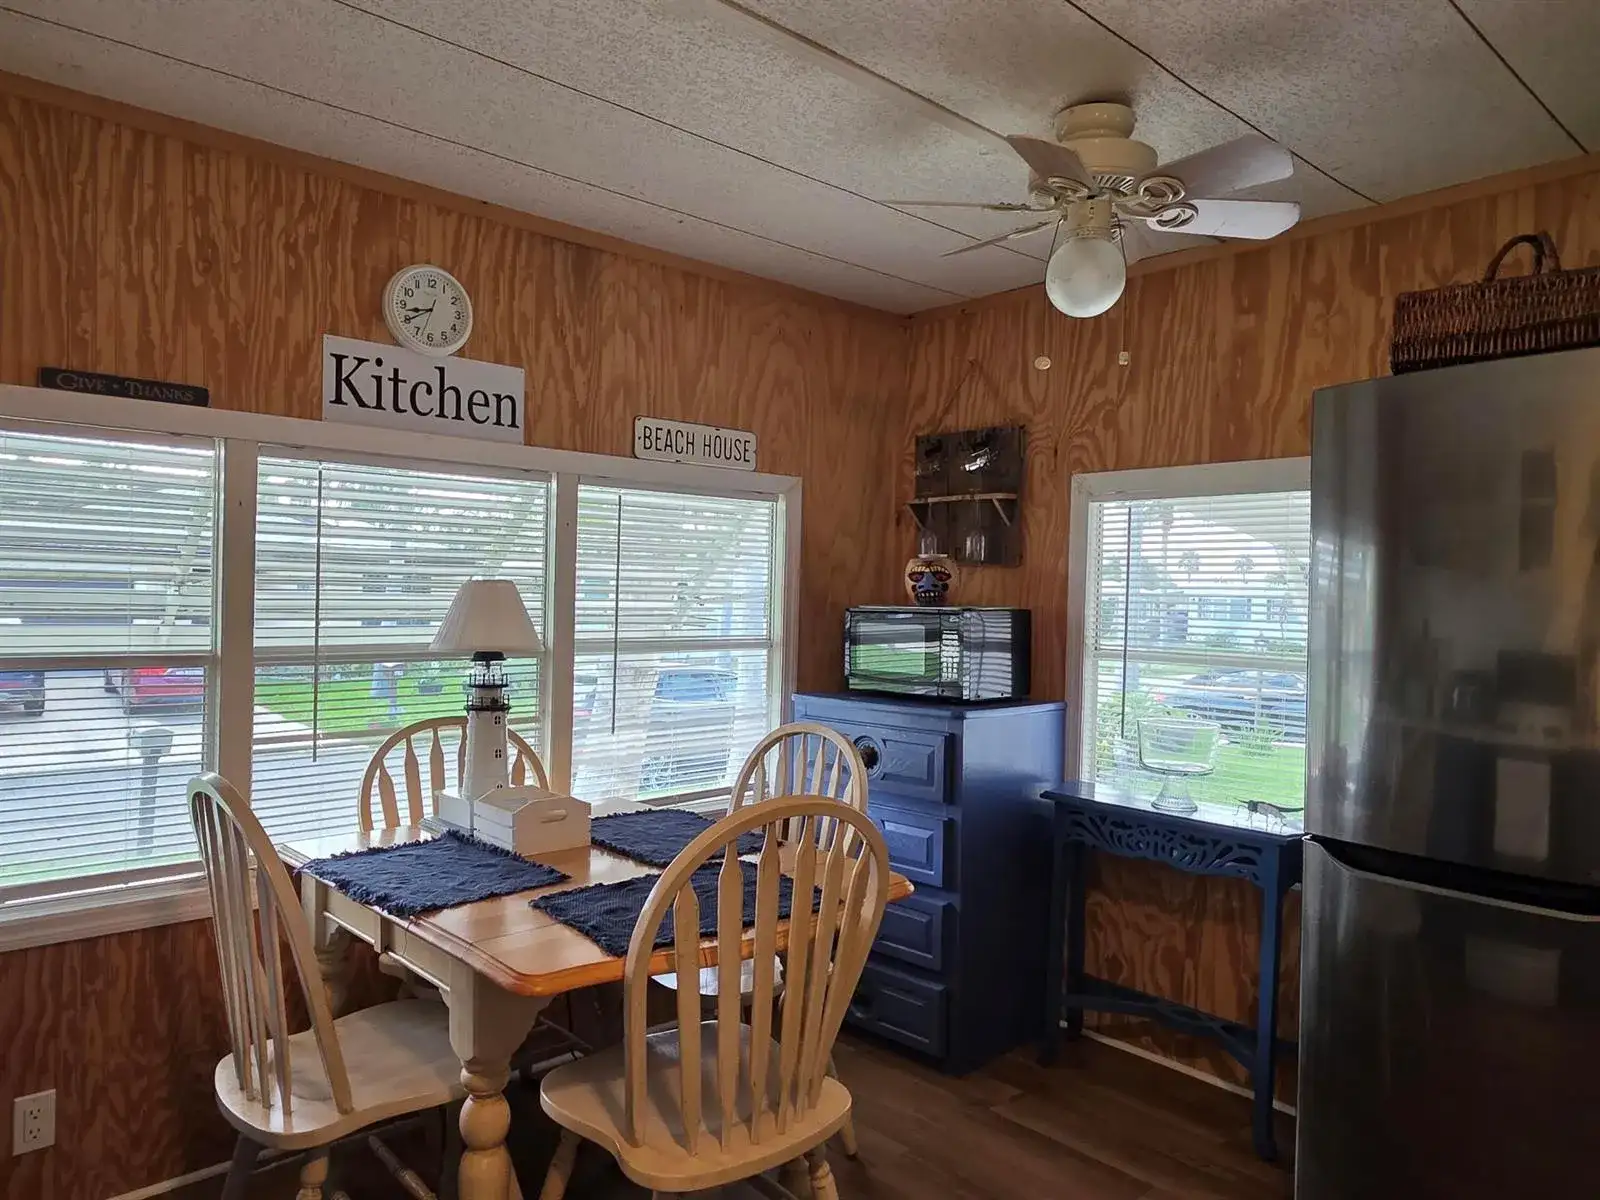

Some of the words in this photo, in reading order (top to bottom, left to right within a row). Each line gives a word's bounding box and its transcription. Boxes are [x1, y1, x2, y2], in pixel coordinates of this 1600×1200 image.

[414, 279, 420, 289] 11
[427, 278, 437, 289] 12
[403, 287, 414, 298] 10
[399, 299, 407, 310] 9
[450, 296, 458, 306] 2
[403, 314, 411, 325] 8
[454, 310, 461, 320] 3
[413, 325, 421, 336] 7
[450, 323, 457, 333] 4
[426, 332, 434, 342] 6
[440, 331, 448, 341] 5
[328, 352, 520, 429] Kitchen
[643, 425, 695, 456] BEACH
[703, 434, 751, 463] HOUSE
